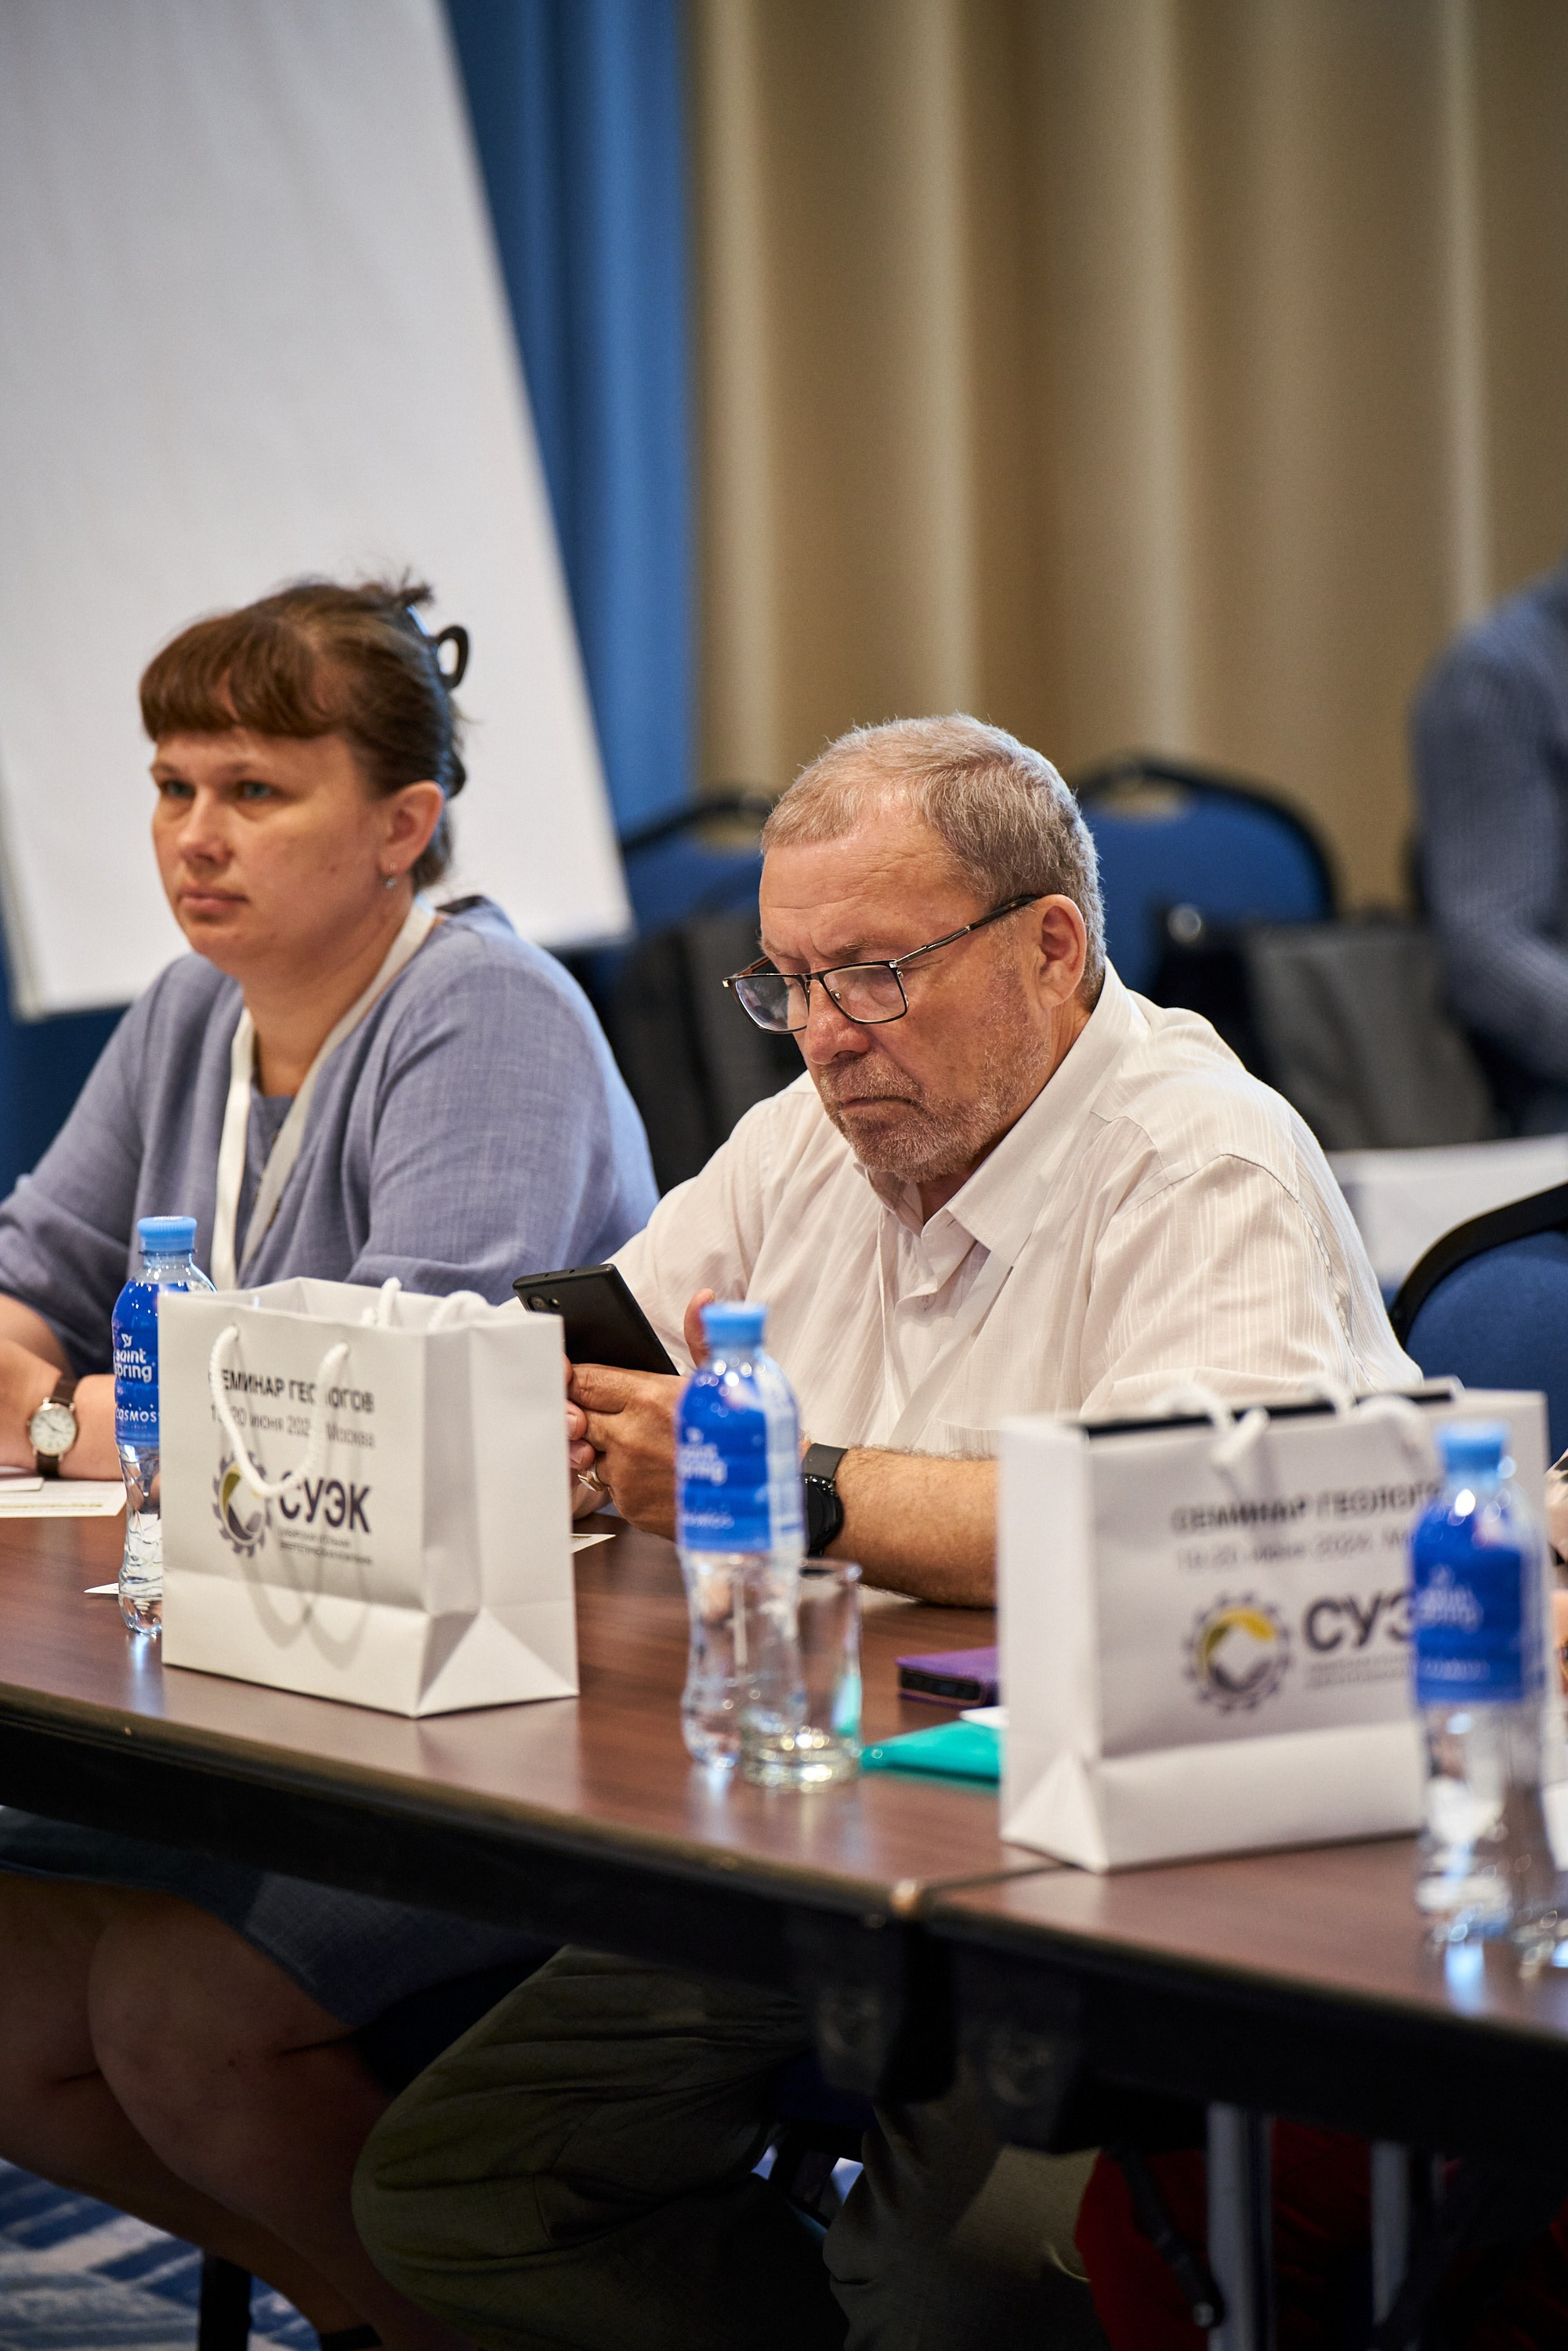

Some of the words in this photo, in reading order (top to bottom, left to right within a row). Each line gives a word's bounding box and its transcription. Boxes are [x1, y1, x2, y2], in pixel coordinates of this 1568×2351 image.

[208, 1369, 284, 1398] ЕМИНАР
[280, 1470, 370, 1533] СУЭК
[1302, 1590, 1413, 1652] СУЭ
